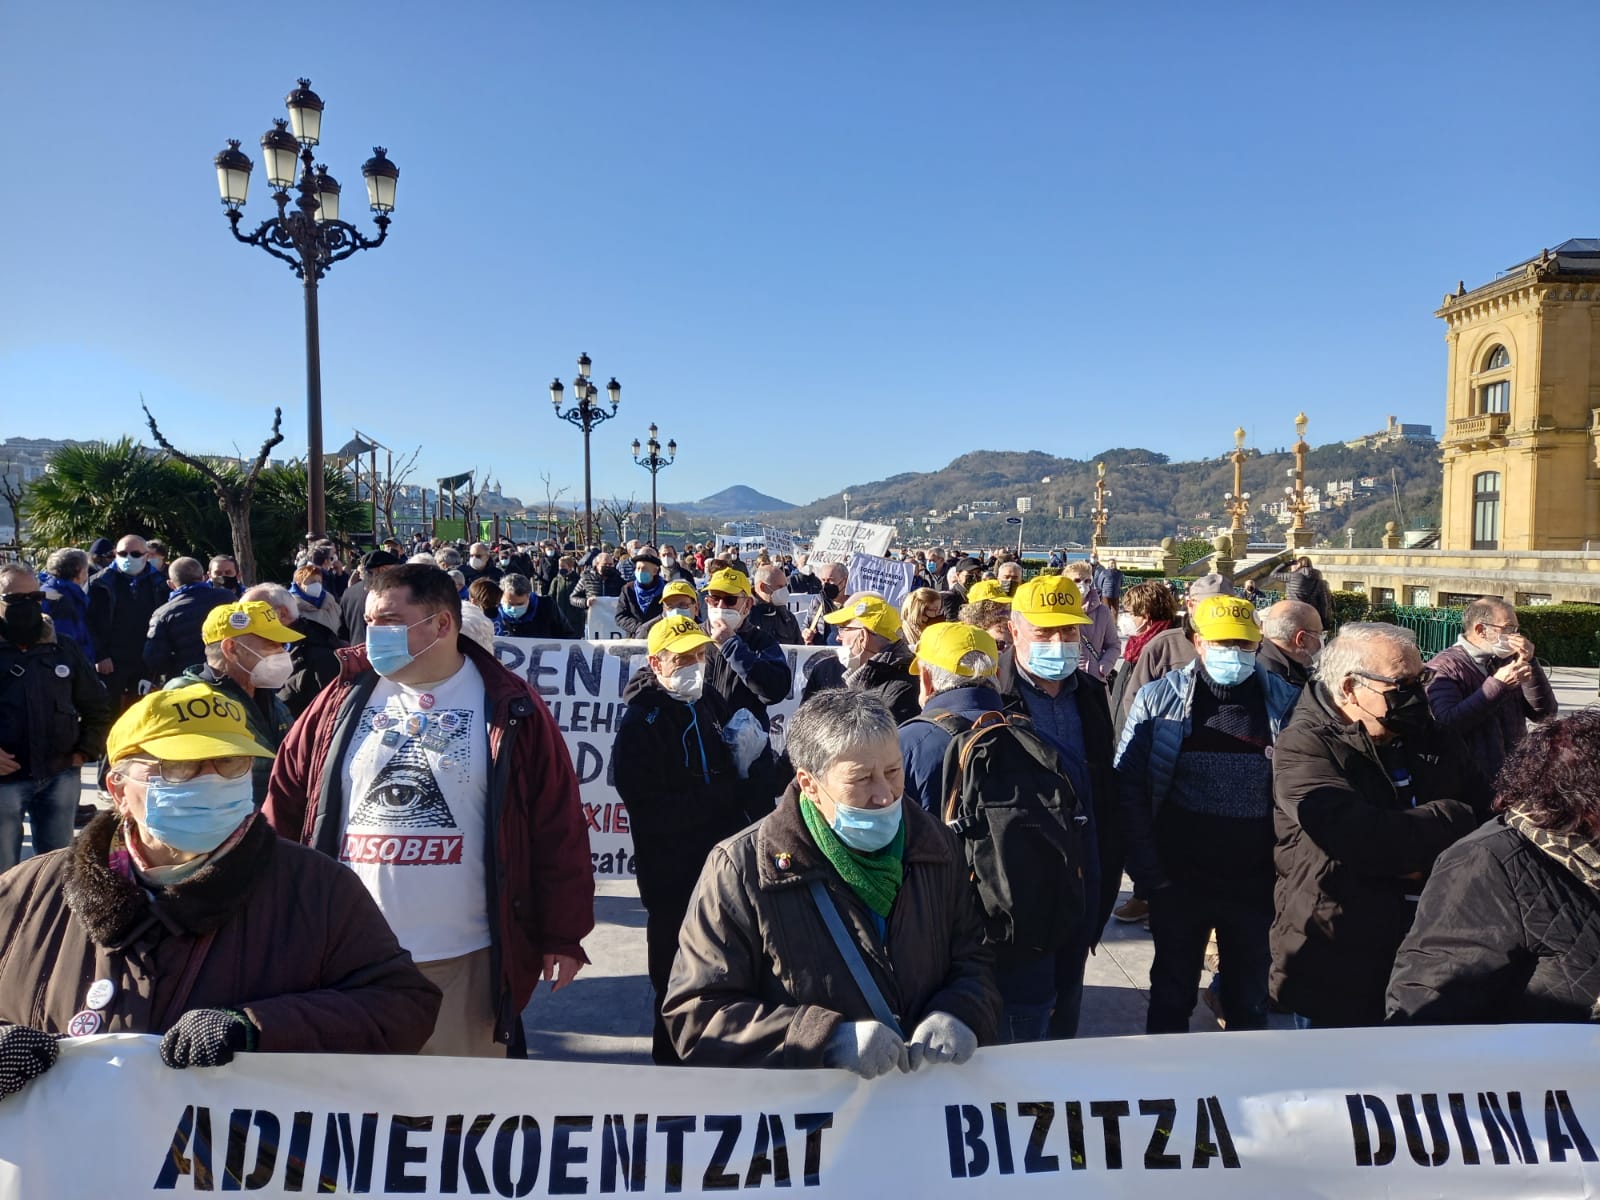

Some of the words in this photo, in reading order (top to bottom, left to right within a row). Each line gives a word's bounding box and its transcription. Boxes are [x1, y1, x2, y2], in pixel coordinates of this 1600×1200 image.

[1040, 592, 1075, 607] 1080
[172, 697, 241, 723] 1080
[343, 836, 460, 861] DISOBEY
[153, 1104, 834, 1198] ADINEKOENTZAT
[945, 1096, 1241, 1178] BIZITZA
[1346, 1090, 1599, 1167] DUINA
